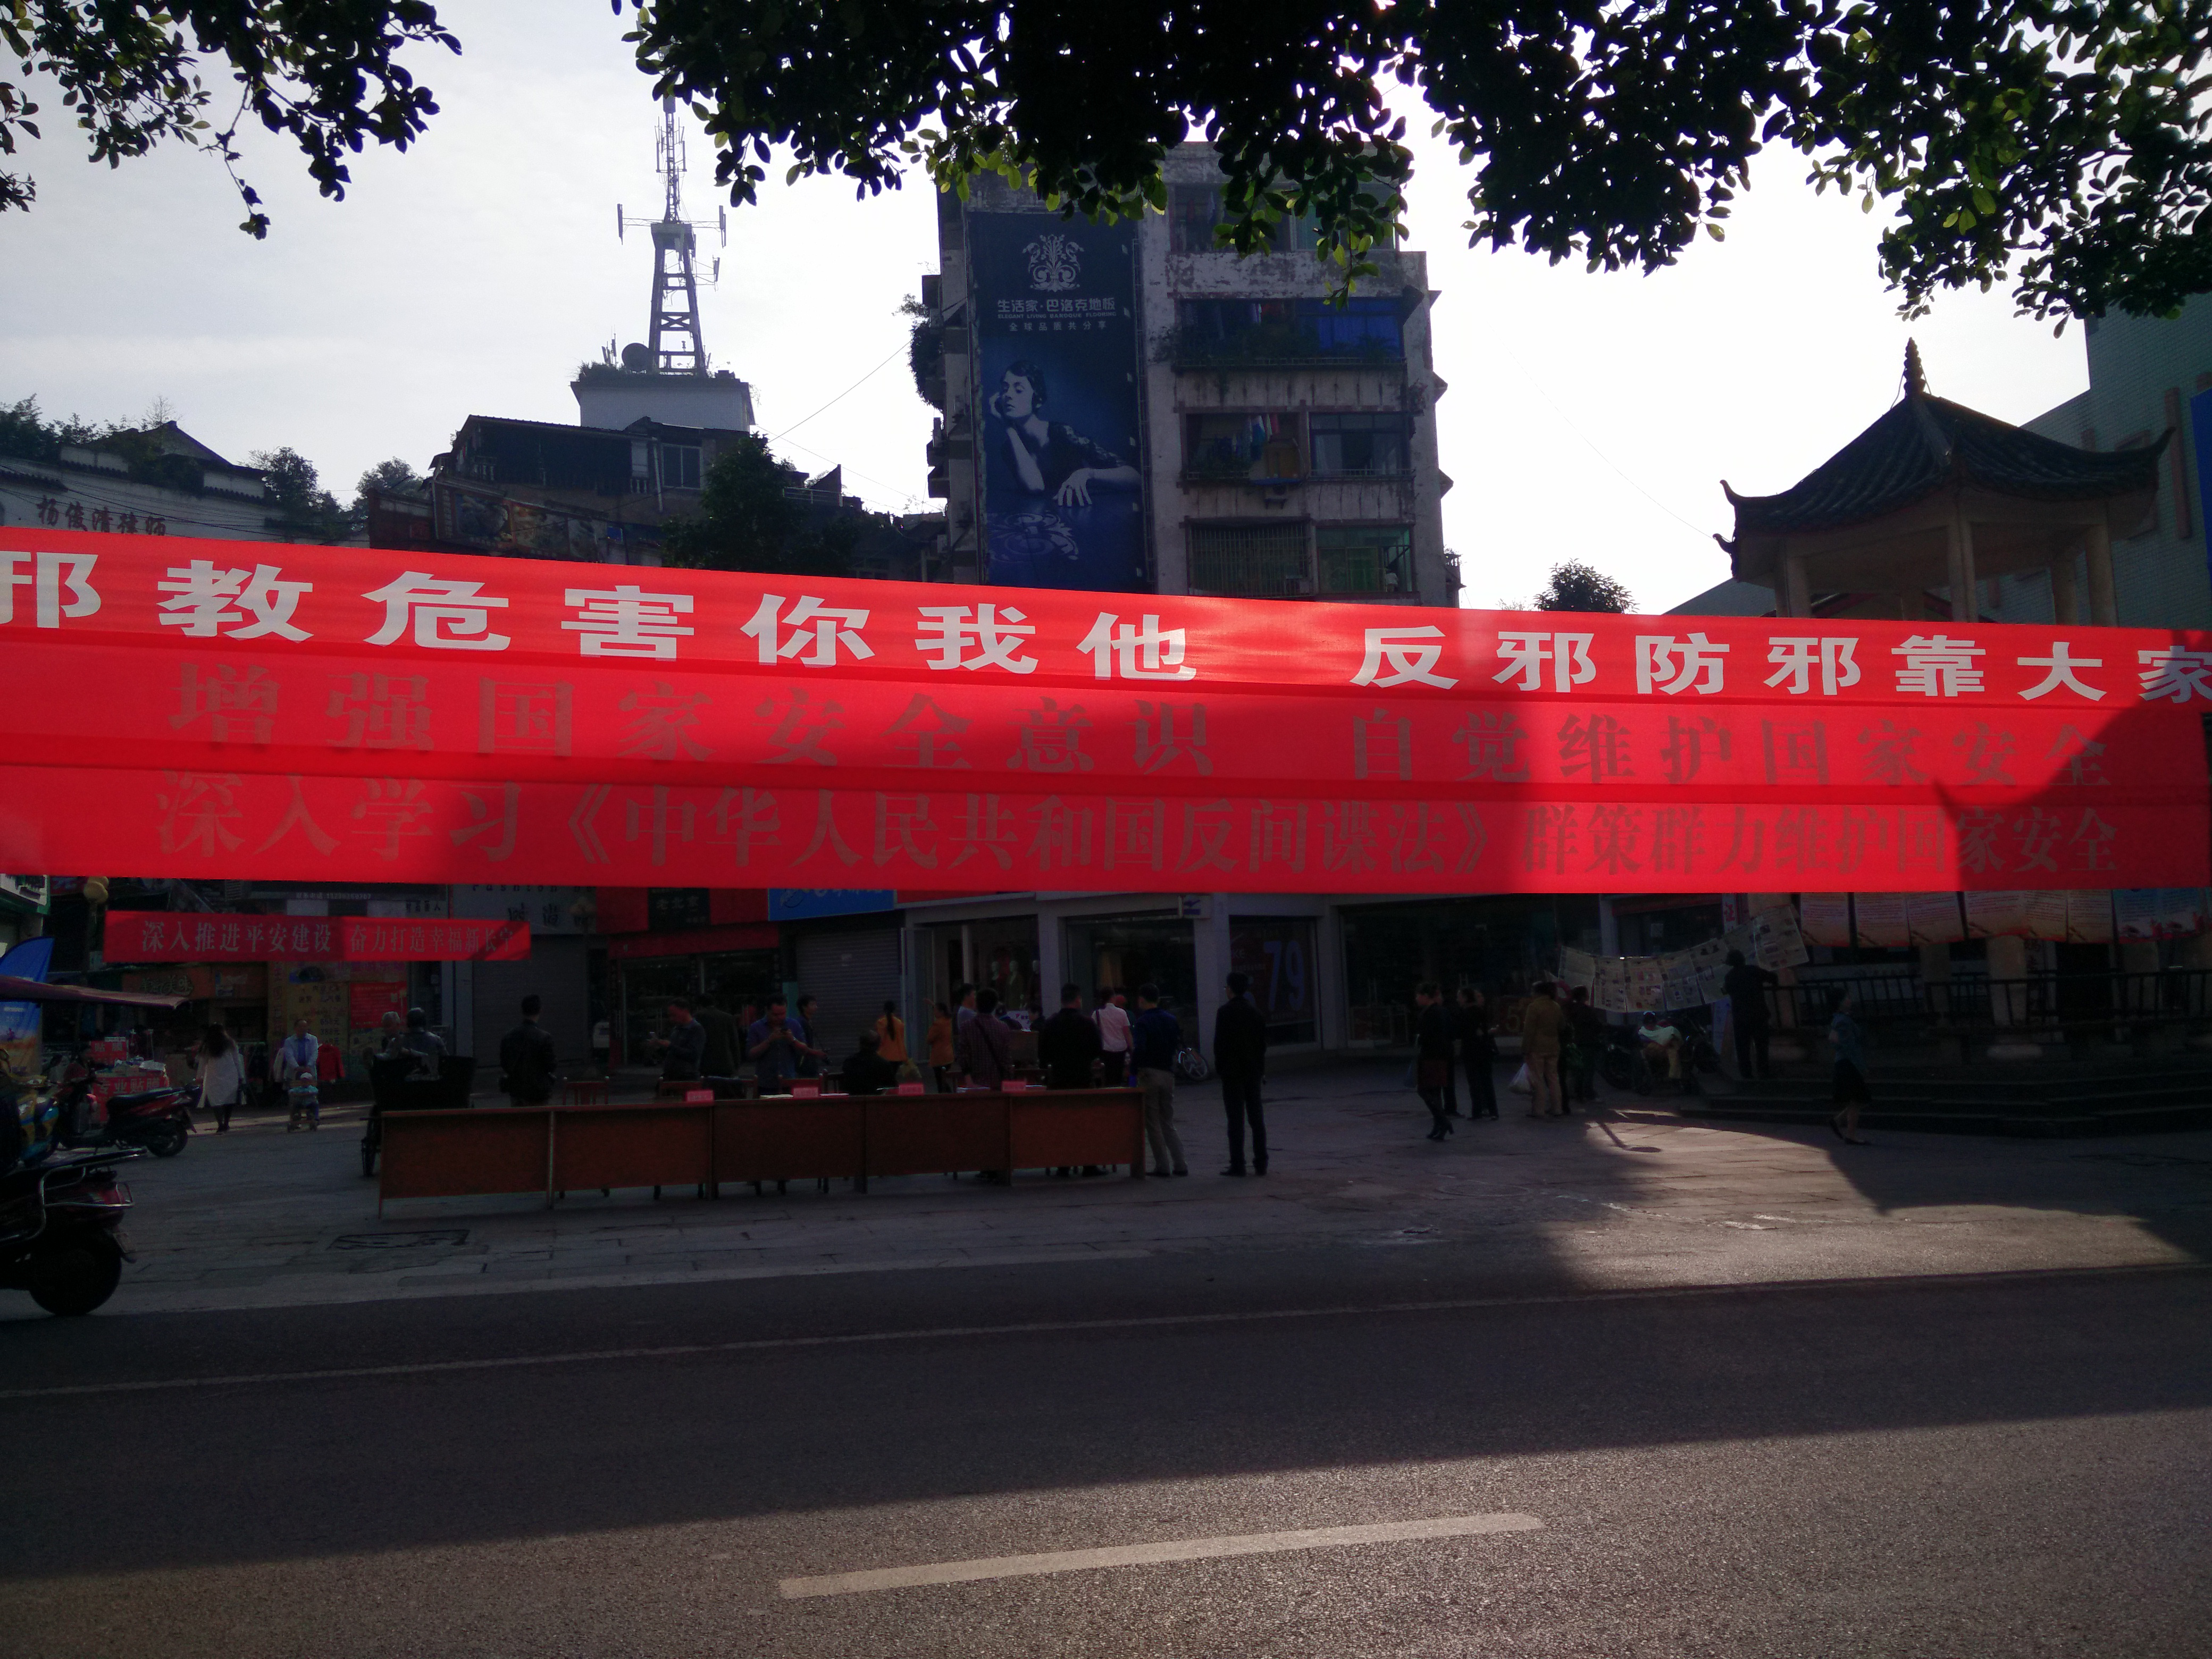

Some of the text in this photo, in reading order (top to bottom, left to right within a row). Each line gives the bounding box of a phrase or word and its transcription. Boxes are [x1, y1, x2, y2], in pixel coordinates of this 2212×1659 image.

[997, 297, 1116, 313] 生活家·巴洛克地板
[1009, 320, 1107, 331] 全球品质共分享
[0, 551, 2212, 703] 邪教危害你我他 反邪防邪靠大家
[167, 663, 2111, 786] 增强国家安全意识 自觉维护国家安全
[142, 920, 514, 953] 深入推进平安建设 奋力打造幸福新长宁
